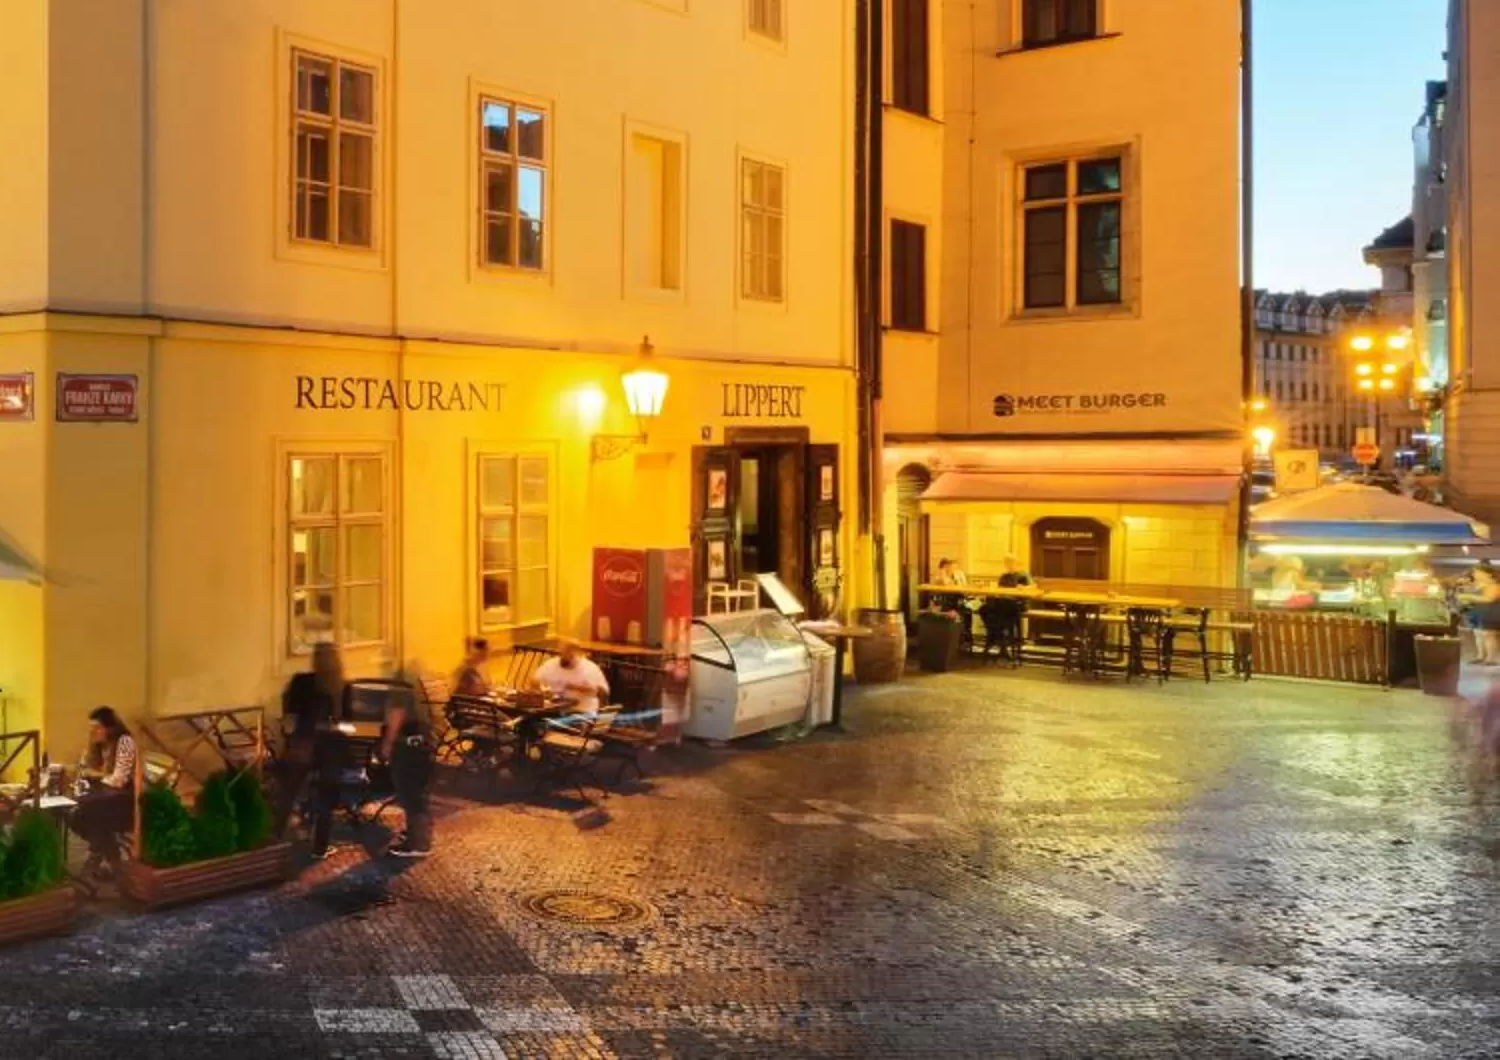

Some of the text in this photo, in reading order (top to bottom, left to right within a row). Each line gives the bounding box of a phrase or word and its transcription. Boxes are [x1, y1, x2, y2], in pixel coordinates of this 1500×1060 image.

[294, 376, 507, 412] RESTAURANT
[721, 383, 805, 417] LIPPERT
[1017, 393, 1167, 409] MEET BURGER
